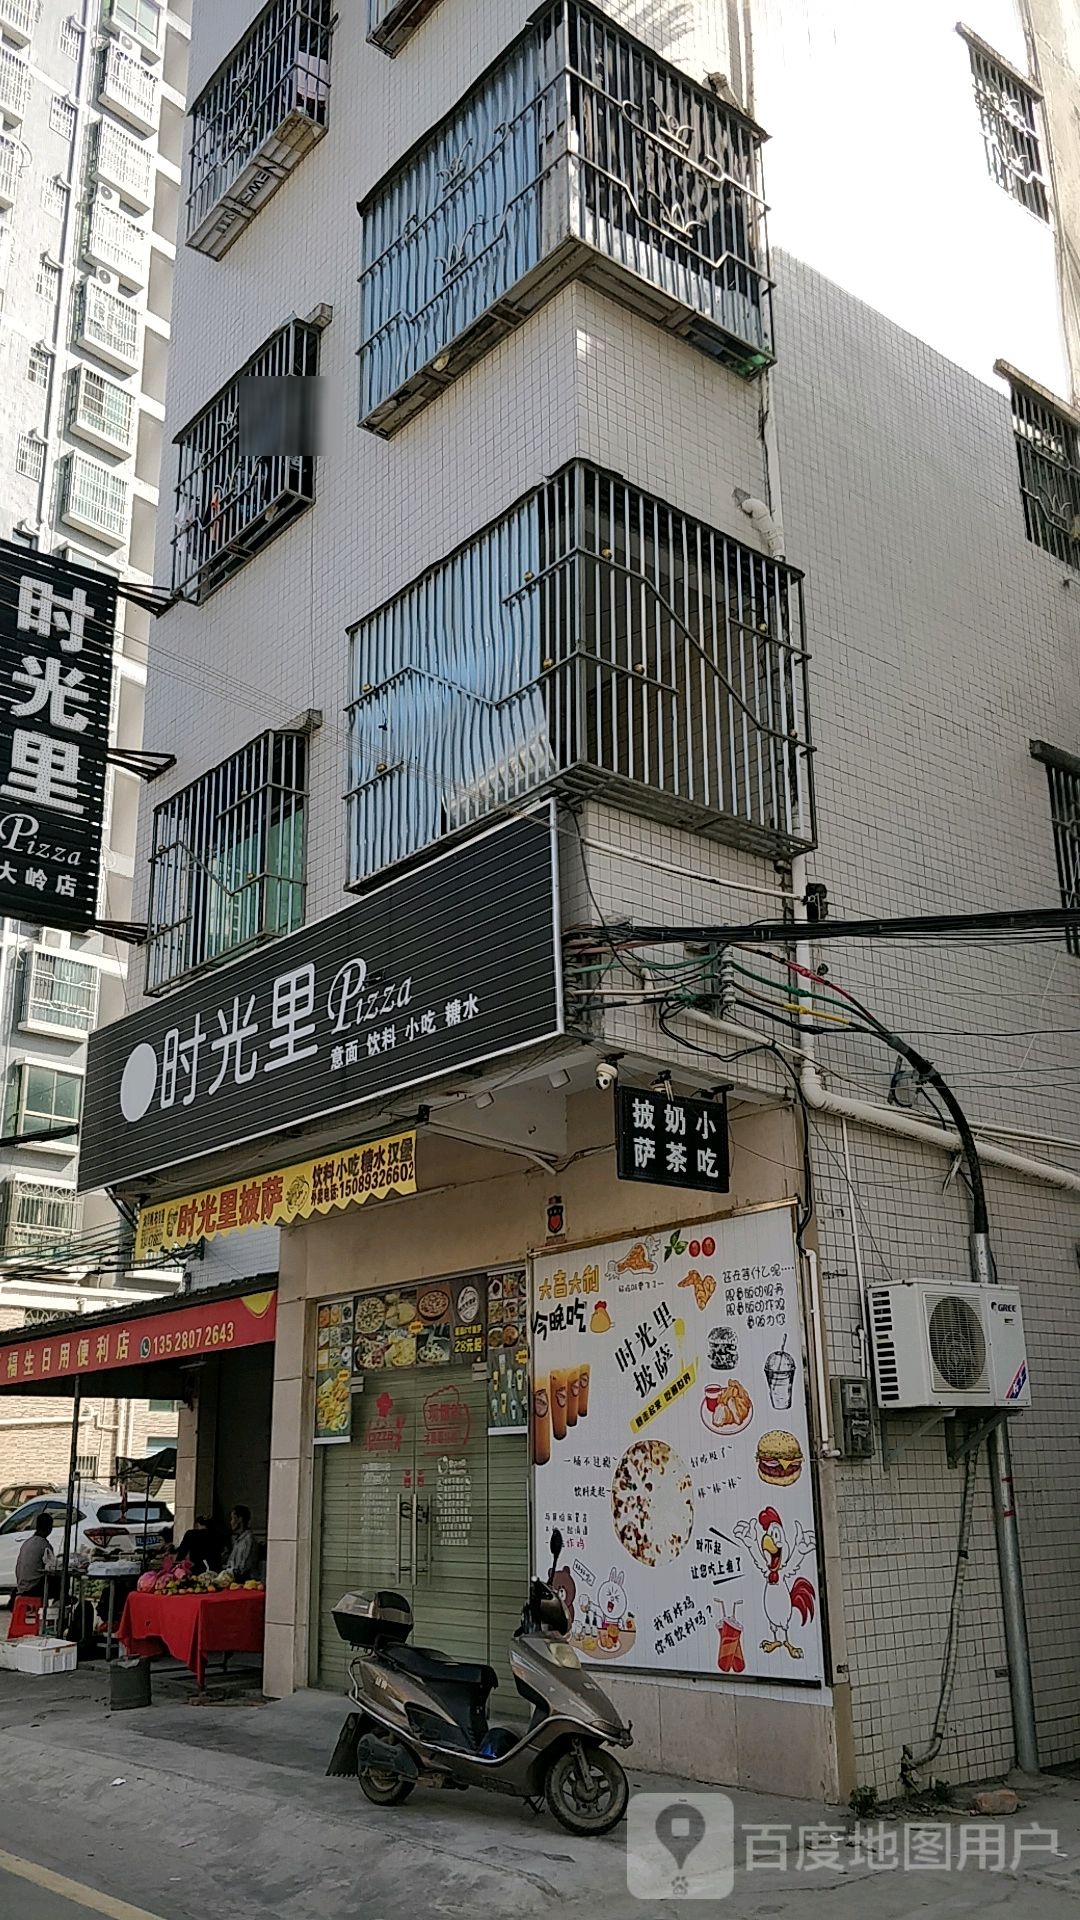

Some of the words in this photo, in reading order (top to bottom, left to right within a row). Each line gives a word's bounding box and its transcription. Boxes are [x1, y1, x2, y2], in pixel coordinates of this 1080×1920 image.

[1, 575, 95, 815] 时光里
[0, 813, 81, 866] Pizza
[0, 860, 77, 897] 大岭店
[327, 957, 413, 1035] Pizza
[160, 962, 318, 1109] 时光里
[330, 1039, 359, 1071] 意面
[366, 1024, 396, 1056] 饮料
[405, 1009, 437, 1041] 小吃
[445, 993, 480, 1027] 糖水
[176, 1175, 284, 1238] 时光里披萨
[532, 1297, 587, 1341] 今晚吃
[615, 1301, 676, 1372] 时光里
[998, 1303, 1016, 1312] GREE
[633, 1343, 674, 1398] 披萨
[696, 1538, 721, 1555] 对不起
